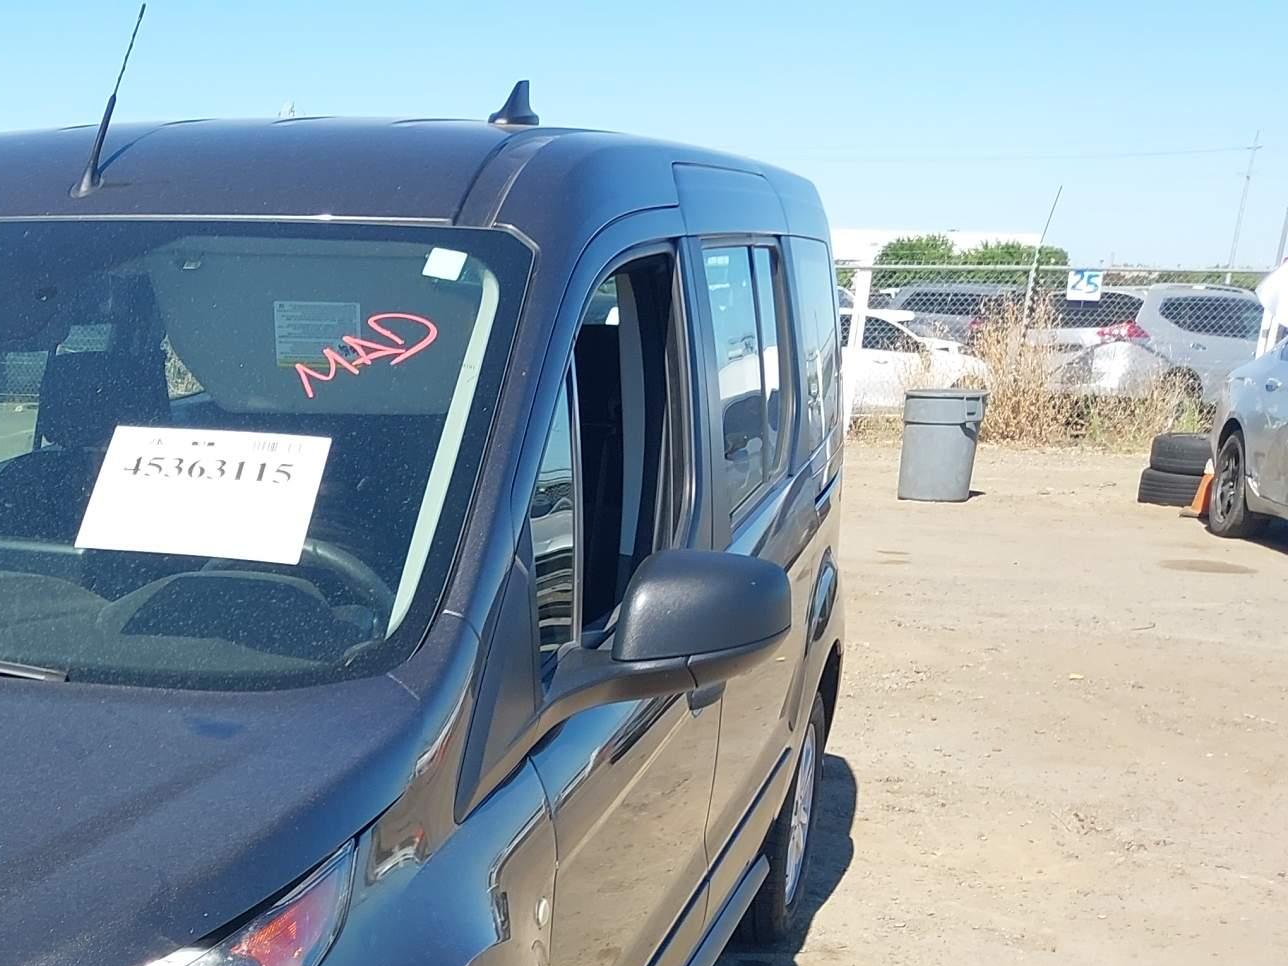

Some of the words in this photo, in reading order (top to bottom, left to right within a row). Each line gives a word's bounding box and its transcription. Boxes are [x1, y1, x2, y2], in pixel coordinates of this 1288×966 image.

[1071, 268, 1100, 294] 25
[295, 312, 438, 398] MAD
[123, 456, 294, 484] 45363115
